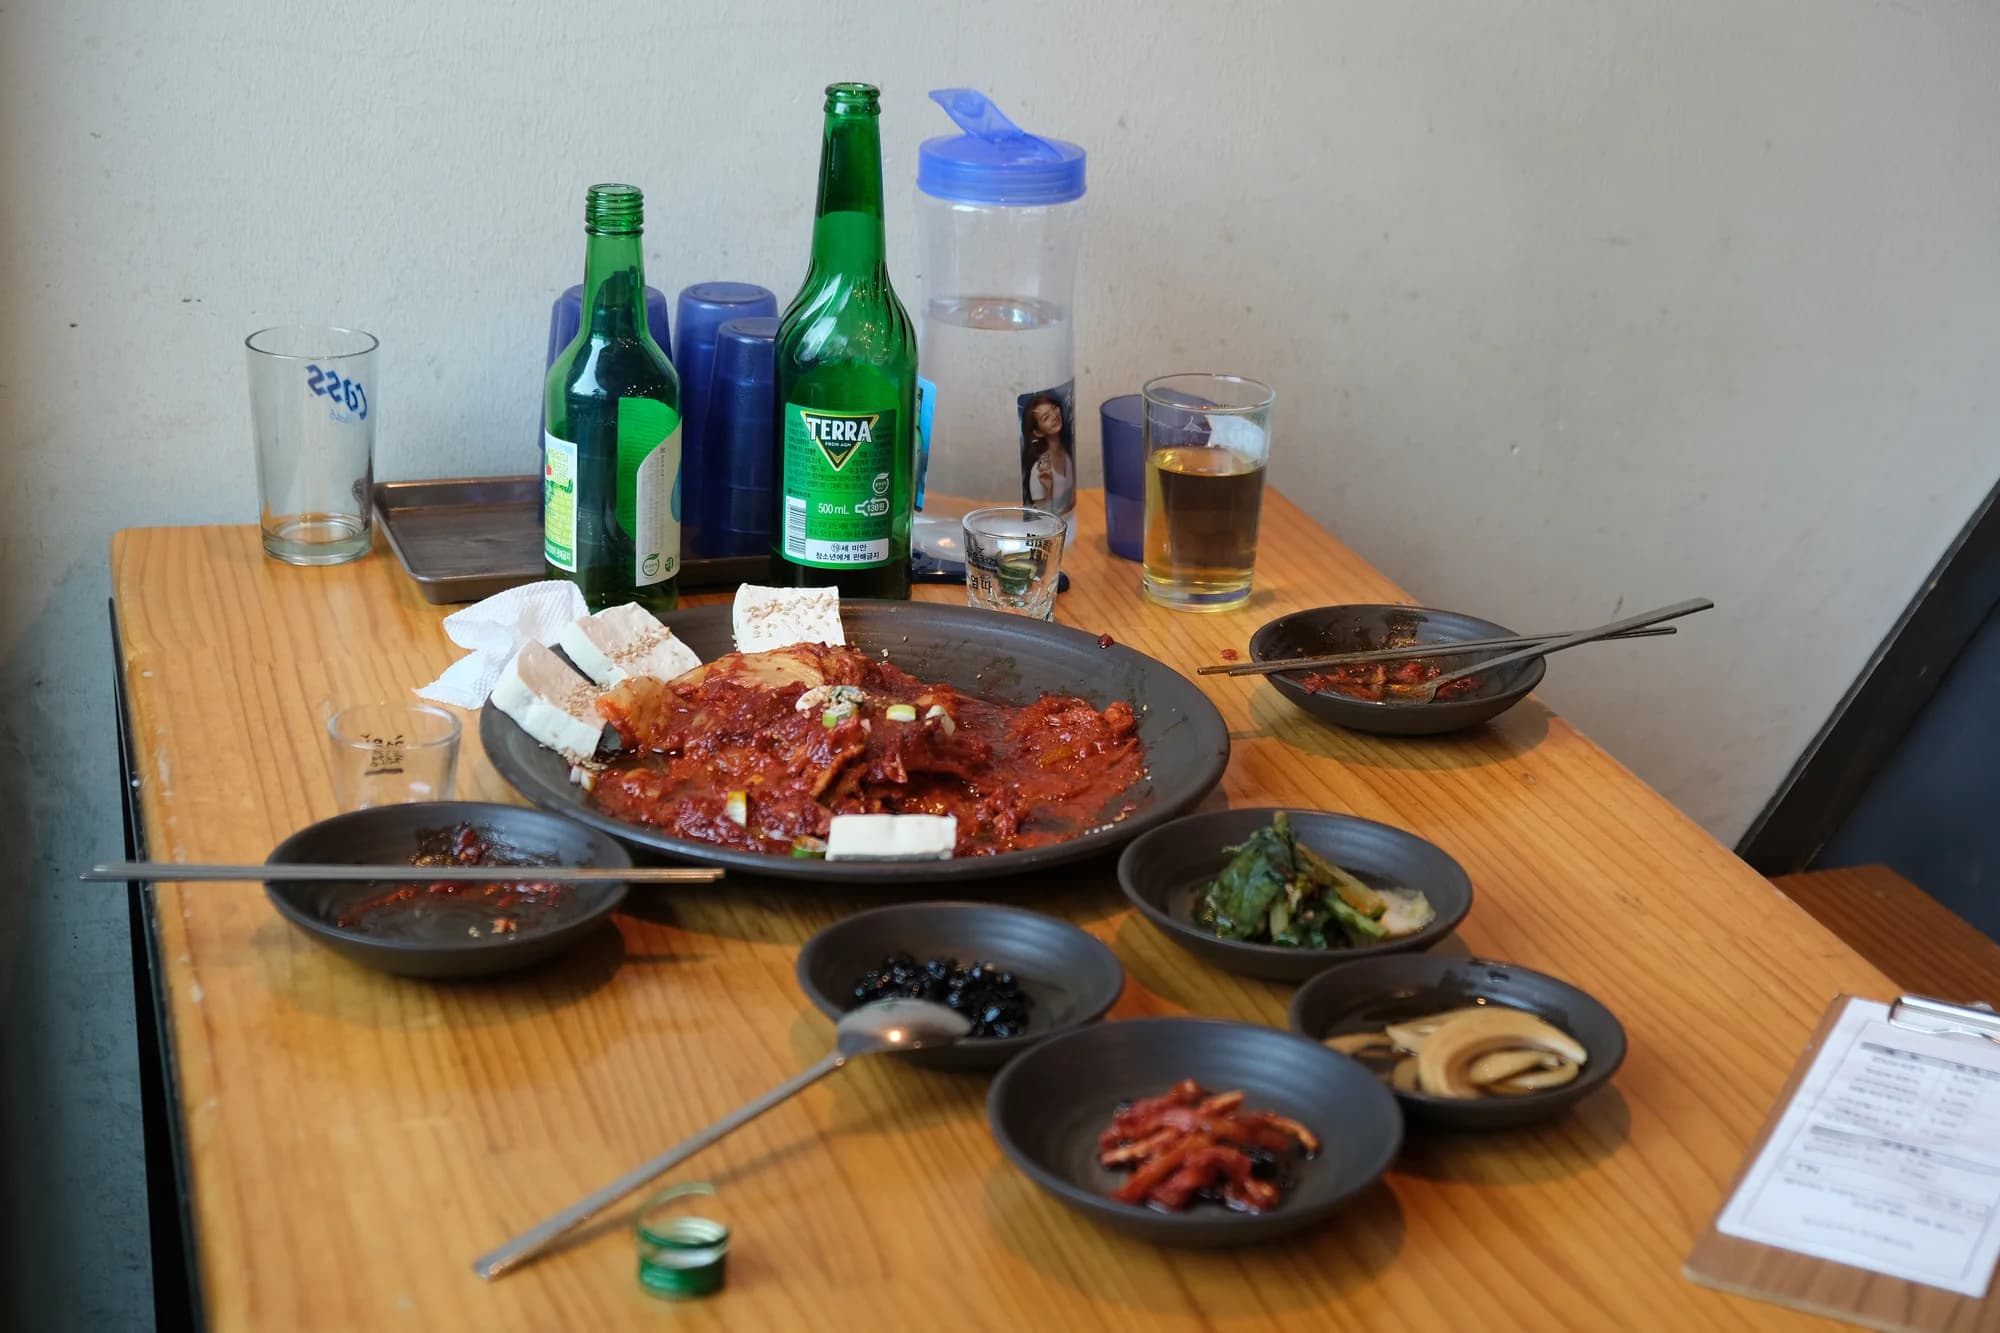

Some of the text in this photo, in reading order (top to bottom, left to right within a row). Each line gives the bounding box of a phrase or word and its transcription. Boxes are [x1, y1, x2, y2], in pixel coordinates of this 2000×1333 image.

[807, 418, 872, 442] TERRA
[818, 503, 849, 514] 500 mL
[852, 544, 867, 552] 미만
[816, 552, 880, 561] 청소년에게 판매금지
